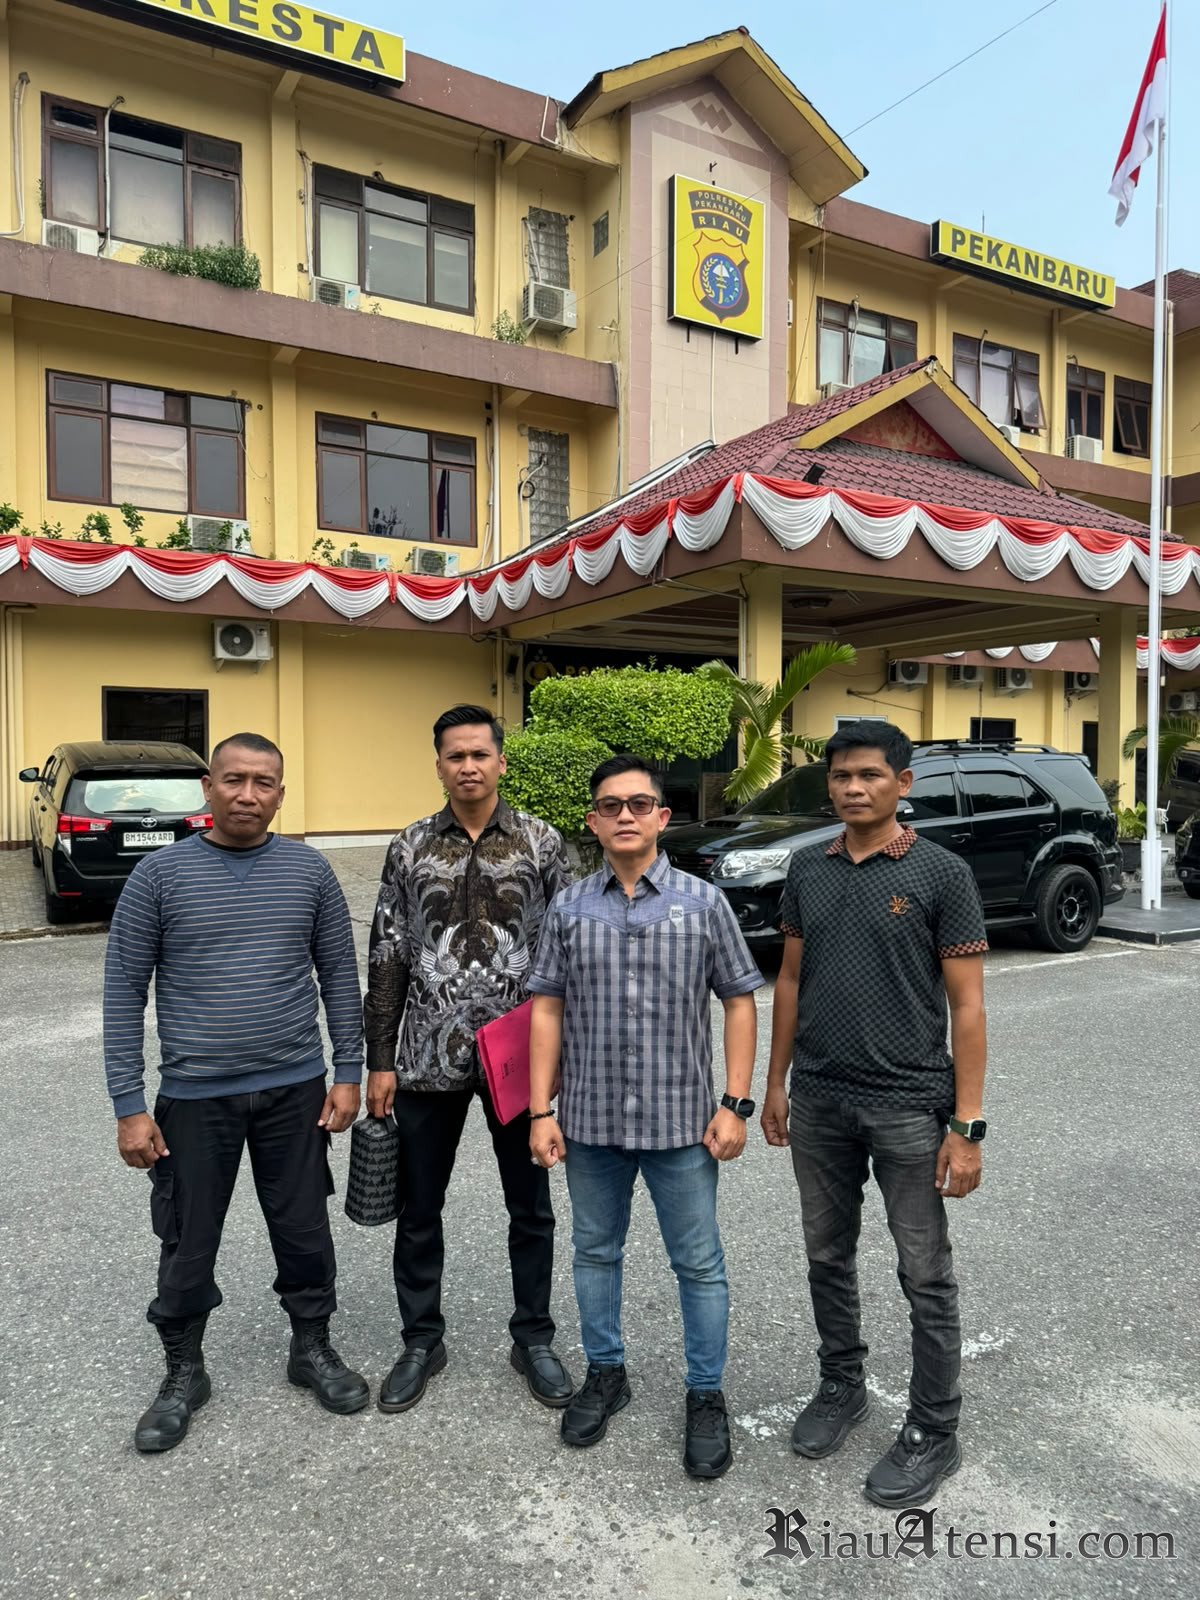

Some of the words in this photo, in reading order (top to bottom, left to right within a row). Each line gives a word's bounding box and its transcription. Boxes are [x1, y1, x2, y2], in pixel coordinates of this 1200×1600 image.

[695, 200, 747, 222] PEKANBARU
[698, 191, 744, 212] POLRESTA
[698, 216, 744, 237] RIAU
[951, 227, 1107, 299] PEKANBARU
[125, 833, 136, 842] BM
[137, 833, 157, 842] 1546
